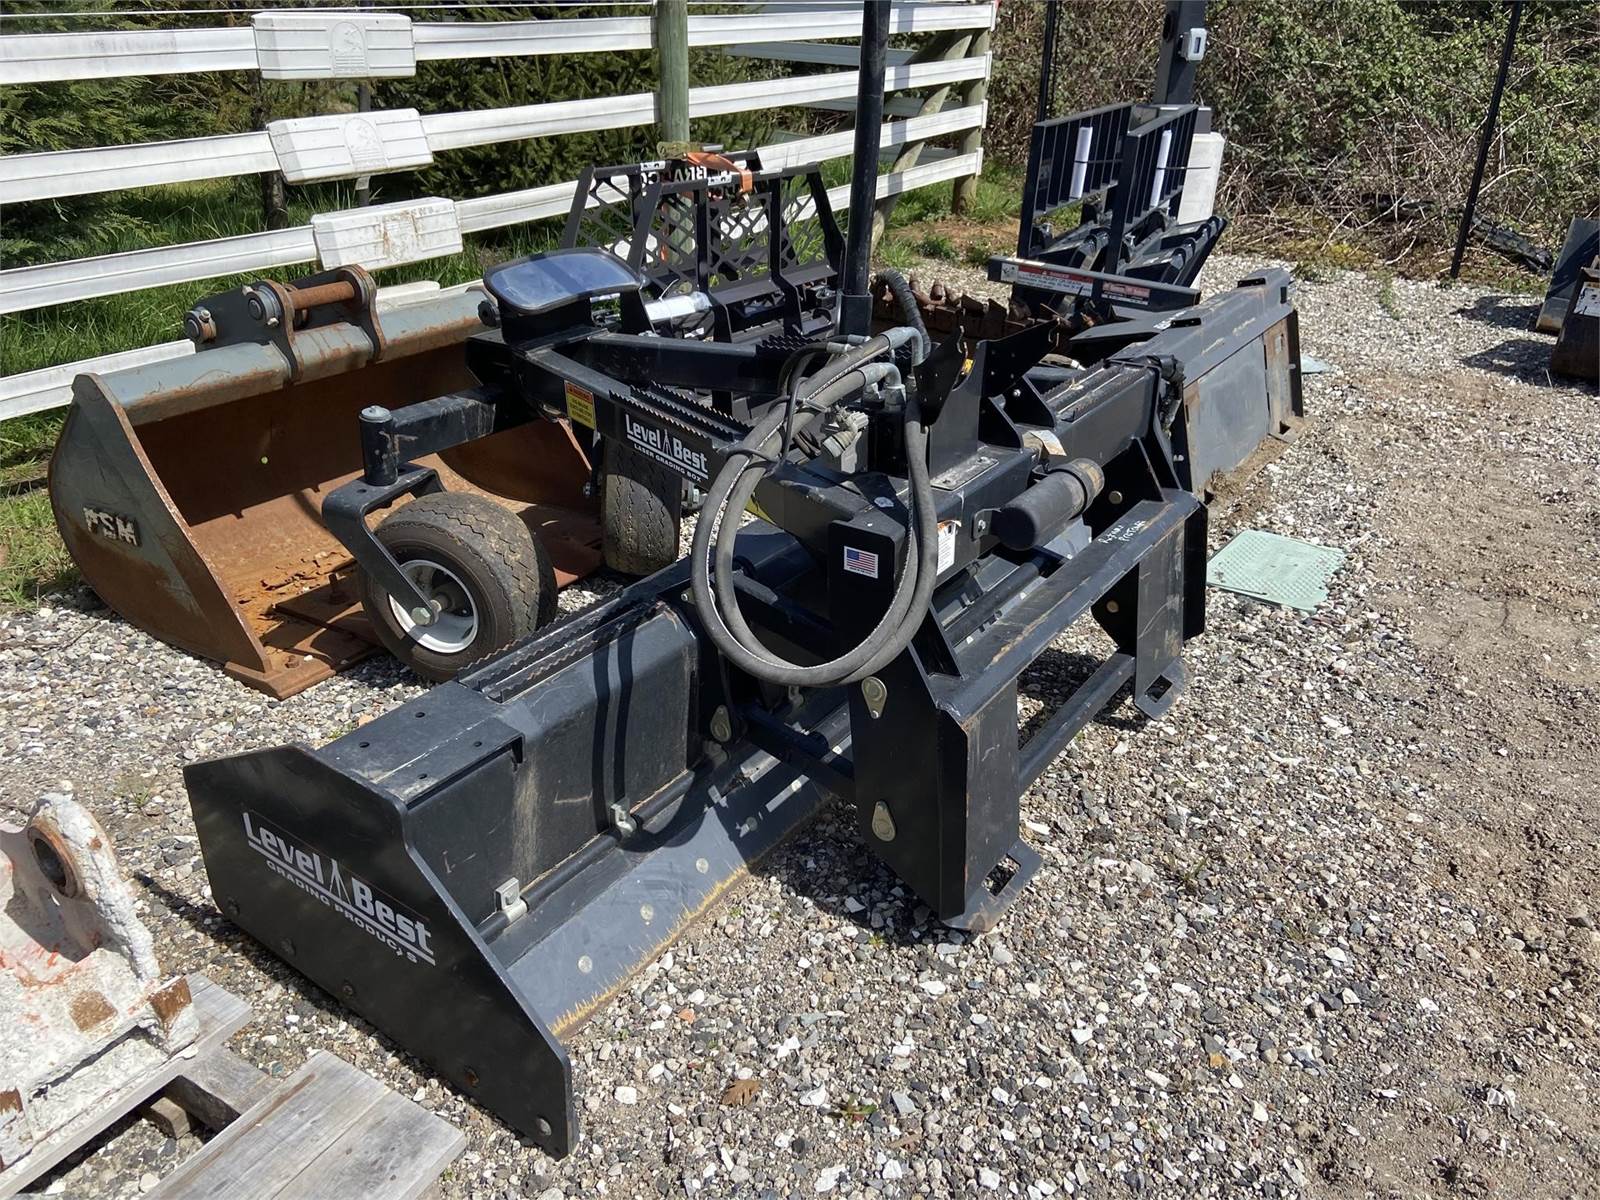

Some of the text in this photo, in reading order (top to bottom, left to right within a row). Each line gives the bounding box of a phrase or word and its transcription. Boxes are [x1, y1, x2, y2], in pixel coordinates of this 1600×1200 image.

[625, 413, 708, 473] Level Best
[633, 443, 702, 482] LASER GRADING BOX
[83, 507, 138, 546] PSM
[243, 812, 434, 956] Level Best
[265, 859, 330, 906] GRADING
